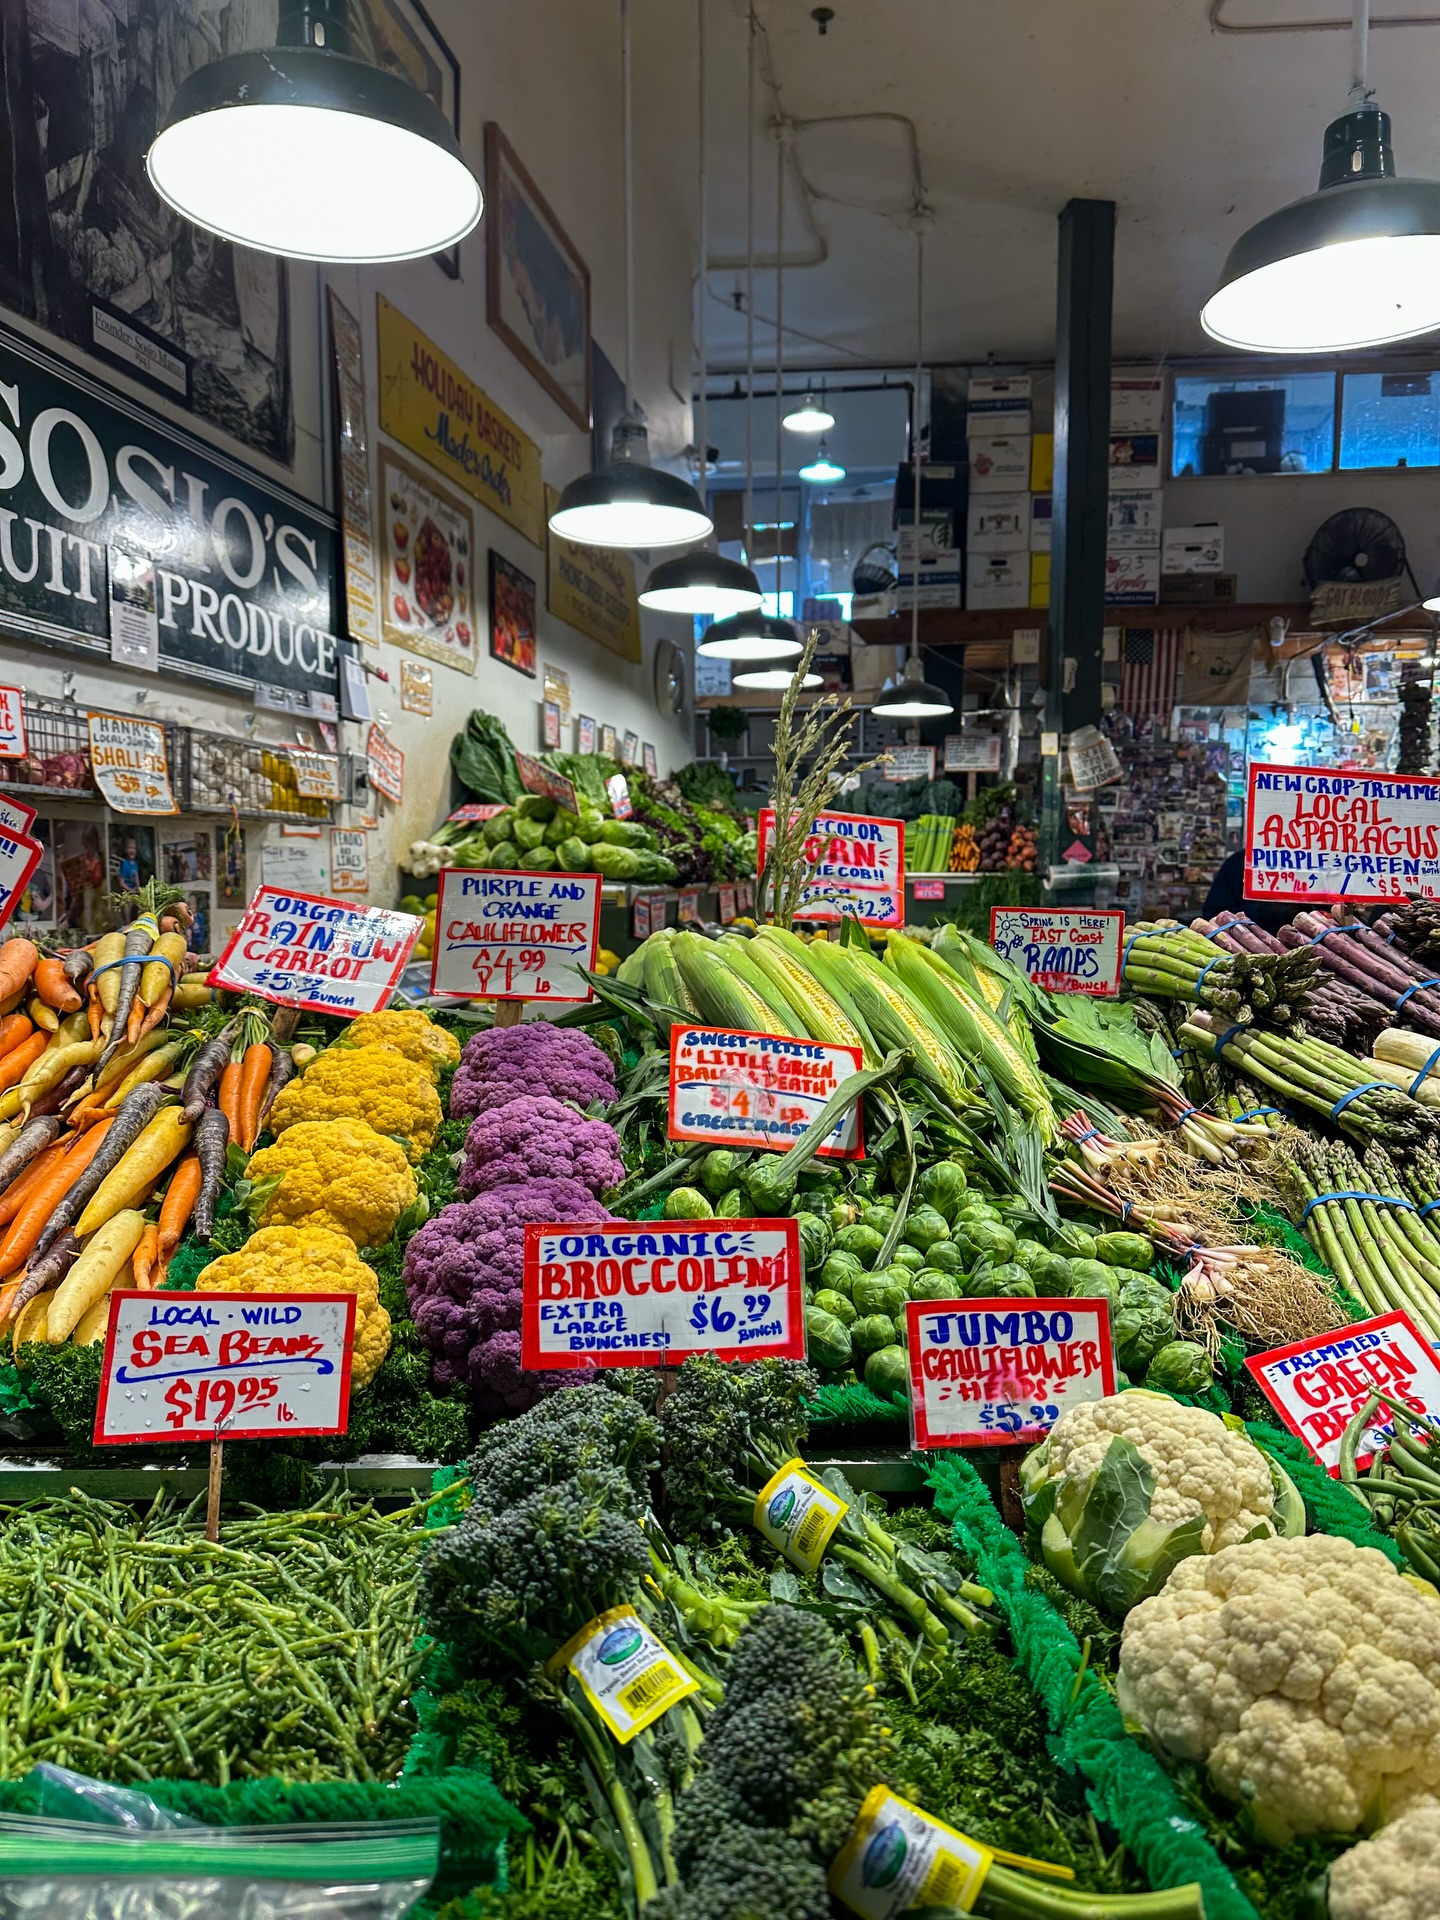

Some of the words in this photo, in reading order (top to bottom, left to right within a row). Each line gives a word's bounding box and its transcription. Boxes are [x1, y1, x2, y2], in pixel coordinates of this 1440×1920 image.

[411, 341, 474, 428] HOLIDAY
[477, 402, 521, 472] BASKETS
[158, 570, 338, 679] PRODUCE
[100, 716, 150, 738] HANK'S
[93, 744, 166, 774] SHALLTS
[1256, 773, 1302, 791] NEW
[1305, 776, 1440, 802] CROP-TRIMME
[1295, 793, 1393, 824] LOCAL
[1257, 814, 1440, 860] ASPARAGUS
[1252, 848, 1330, 871] PURPLE
[1345, 854, 1421, 876] GREEN
[462, 877, 542, 898] PURPLE
[548, 883, 585, 900] AND
[483, 901, 562, 921] ORANGE
[446, 920, 587, 944] CAULIFLOWER
[1031, 928, 1066, 943] EAST
[243, 940, 373, 981] CARROT
[1023, 943, 1099, 978] RAMPS
[308, 991, 355, 1006] BUNCH
[777, 1058, 833, 1079] GREEN
[559, 1233, 739, 1257] ORGANIC
[539, 1247, 795, 1300] BROCCOLINI
[148, 1306, 220, 1327] LOCAL
[241, 1306, 302, 1326] WILD
[541, 1301, 624, 1320] EXTRA
[553, 1317, 628, 1335] LARGE
[570, 1332, 671, 1350] BUNCHES!
[738, 1320, 782, 1343] BUNCH
[925, 1310, 1074, 1347] JUMBO
[921, 1340, 1103, 1382] CAULIFLOWER
[1272, 1334, 1382, 1376] TRIMMED
[1292, 1342, 1418, 1408] GREEN
[978, 1403, 1060, 1433] $5.99
[598, 1678, 620, 1697] Organic
